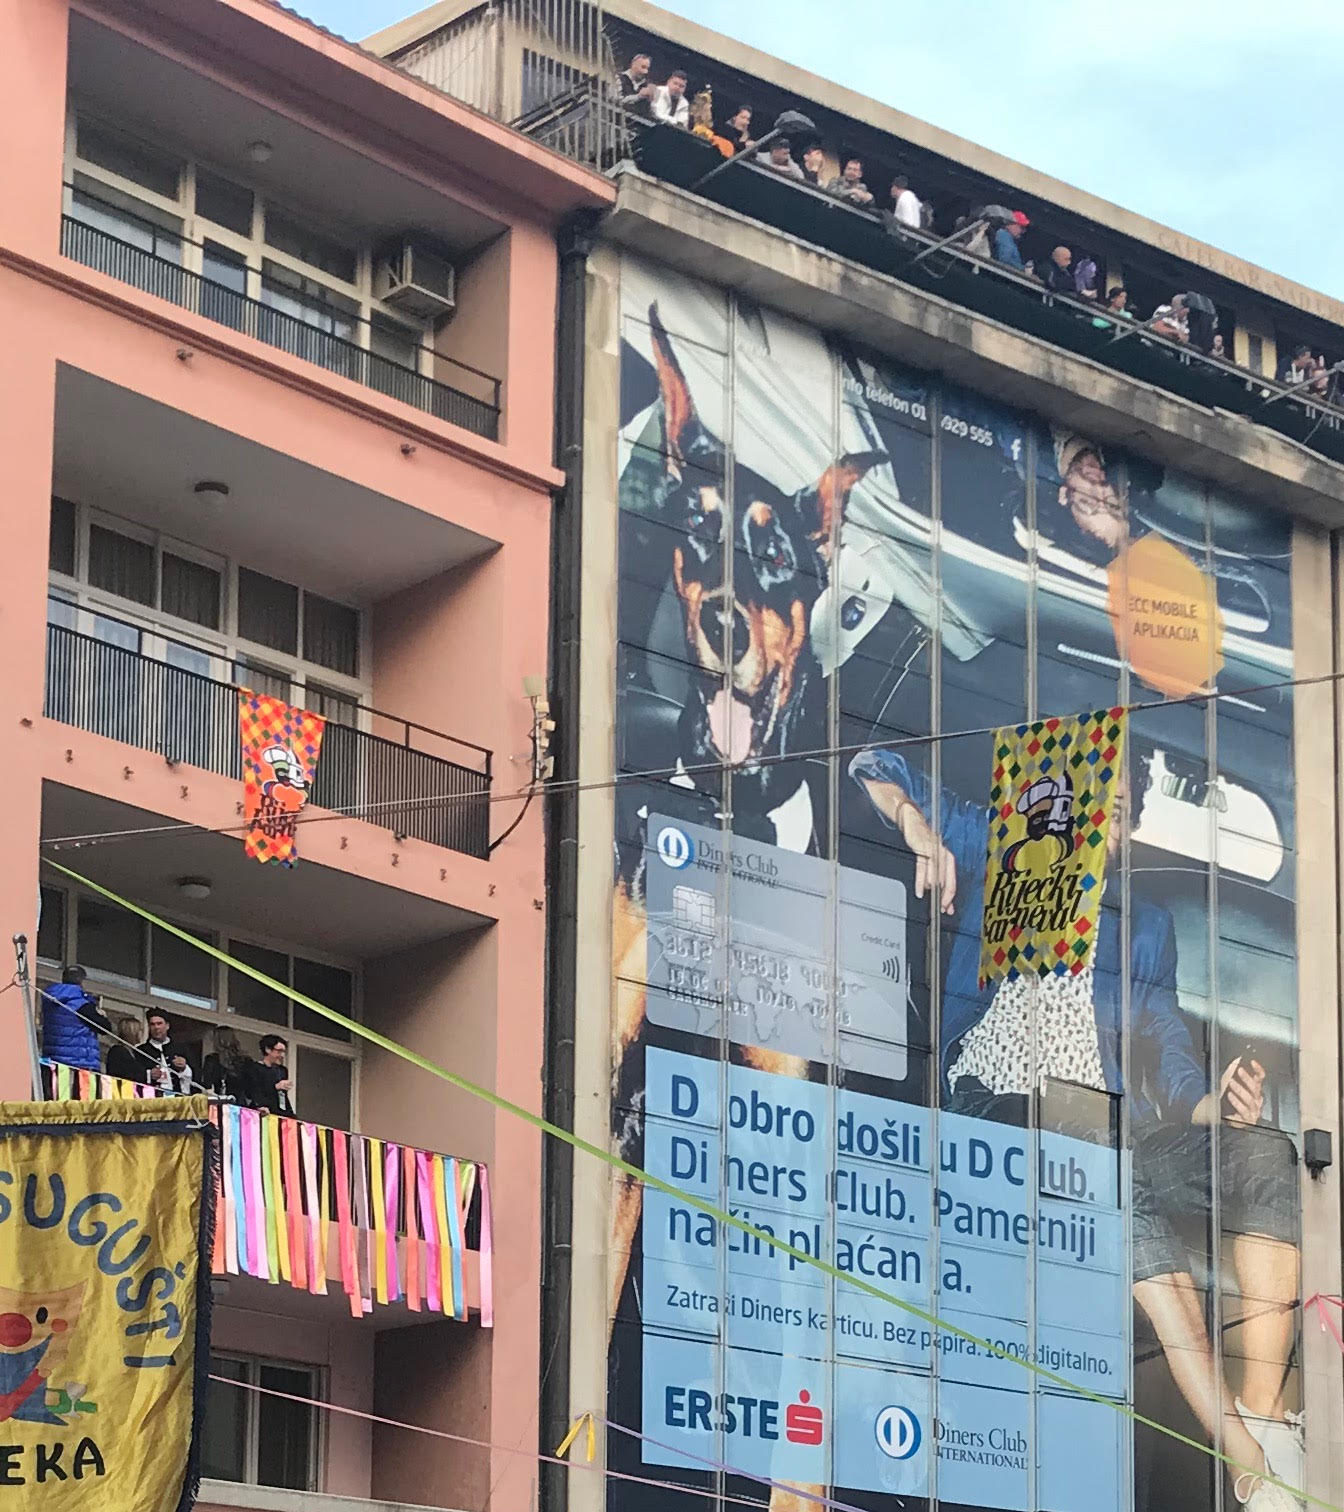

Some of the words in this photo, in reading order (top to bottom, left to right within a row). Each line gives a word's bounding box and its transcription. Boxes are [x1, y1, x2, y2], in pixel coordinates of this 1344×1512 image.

[843, 377, 863, 396] nfo
[866, 383, 909, 414] telefon
[970, 425, 994, 447] 555
[1133, 621, 1200, 642] APLIKACIJA
[1151, 600, 1198, 620] MOBILE
[698, 840, 744, 871] Dinrs
[746, 853, 779, 877] Club
[671, 1074, 814, 1142] Dobro
[837, 1111, 921, 1166] došli
[940, 1140, 957, 1174] u
[671, 1136, 807, 1202] Diners
[937, 1188, 1096, 1263] Pametniji
[789, 1223, 973, 1295] plaćana.
[741, 1297, 803, 1327] Diners
[883, 1320, 917, 1346] Bez
[985, 1337, 1031, 1363] 100%
[1034, 1344, 1113, 1376] digitalno.
[665, 1385, 779, 1440] ERSTE
[936, 1446, 1029, 1471] NTERNATIONAL
[988, 1428, 1028, 1454] Club
